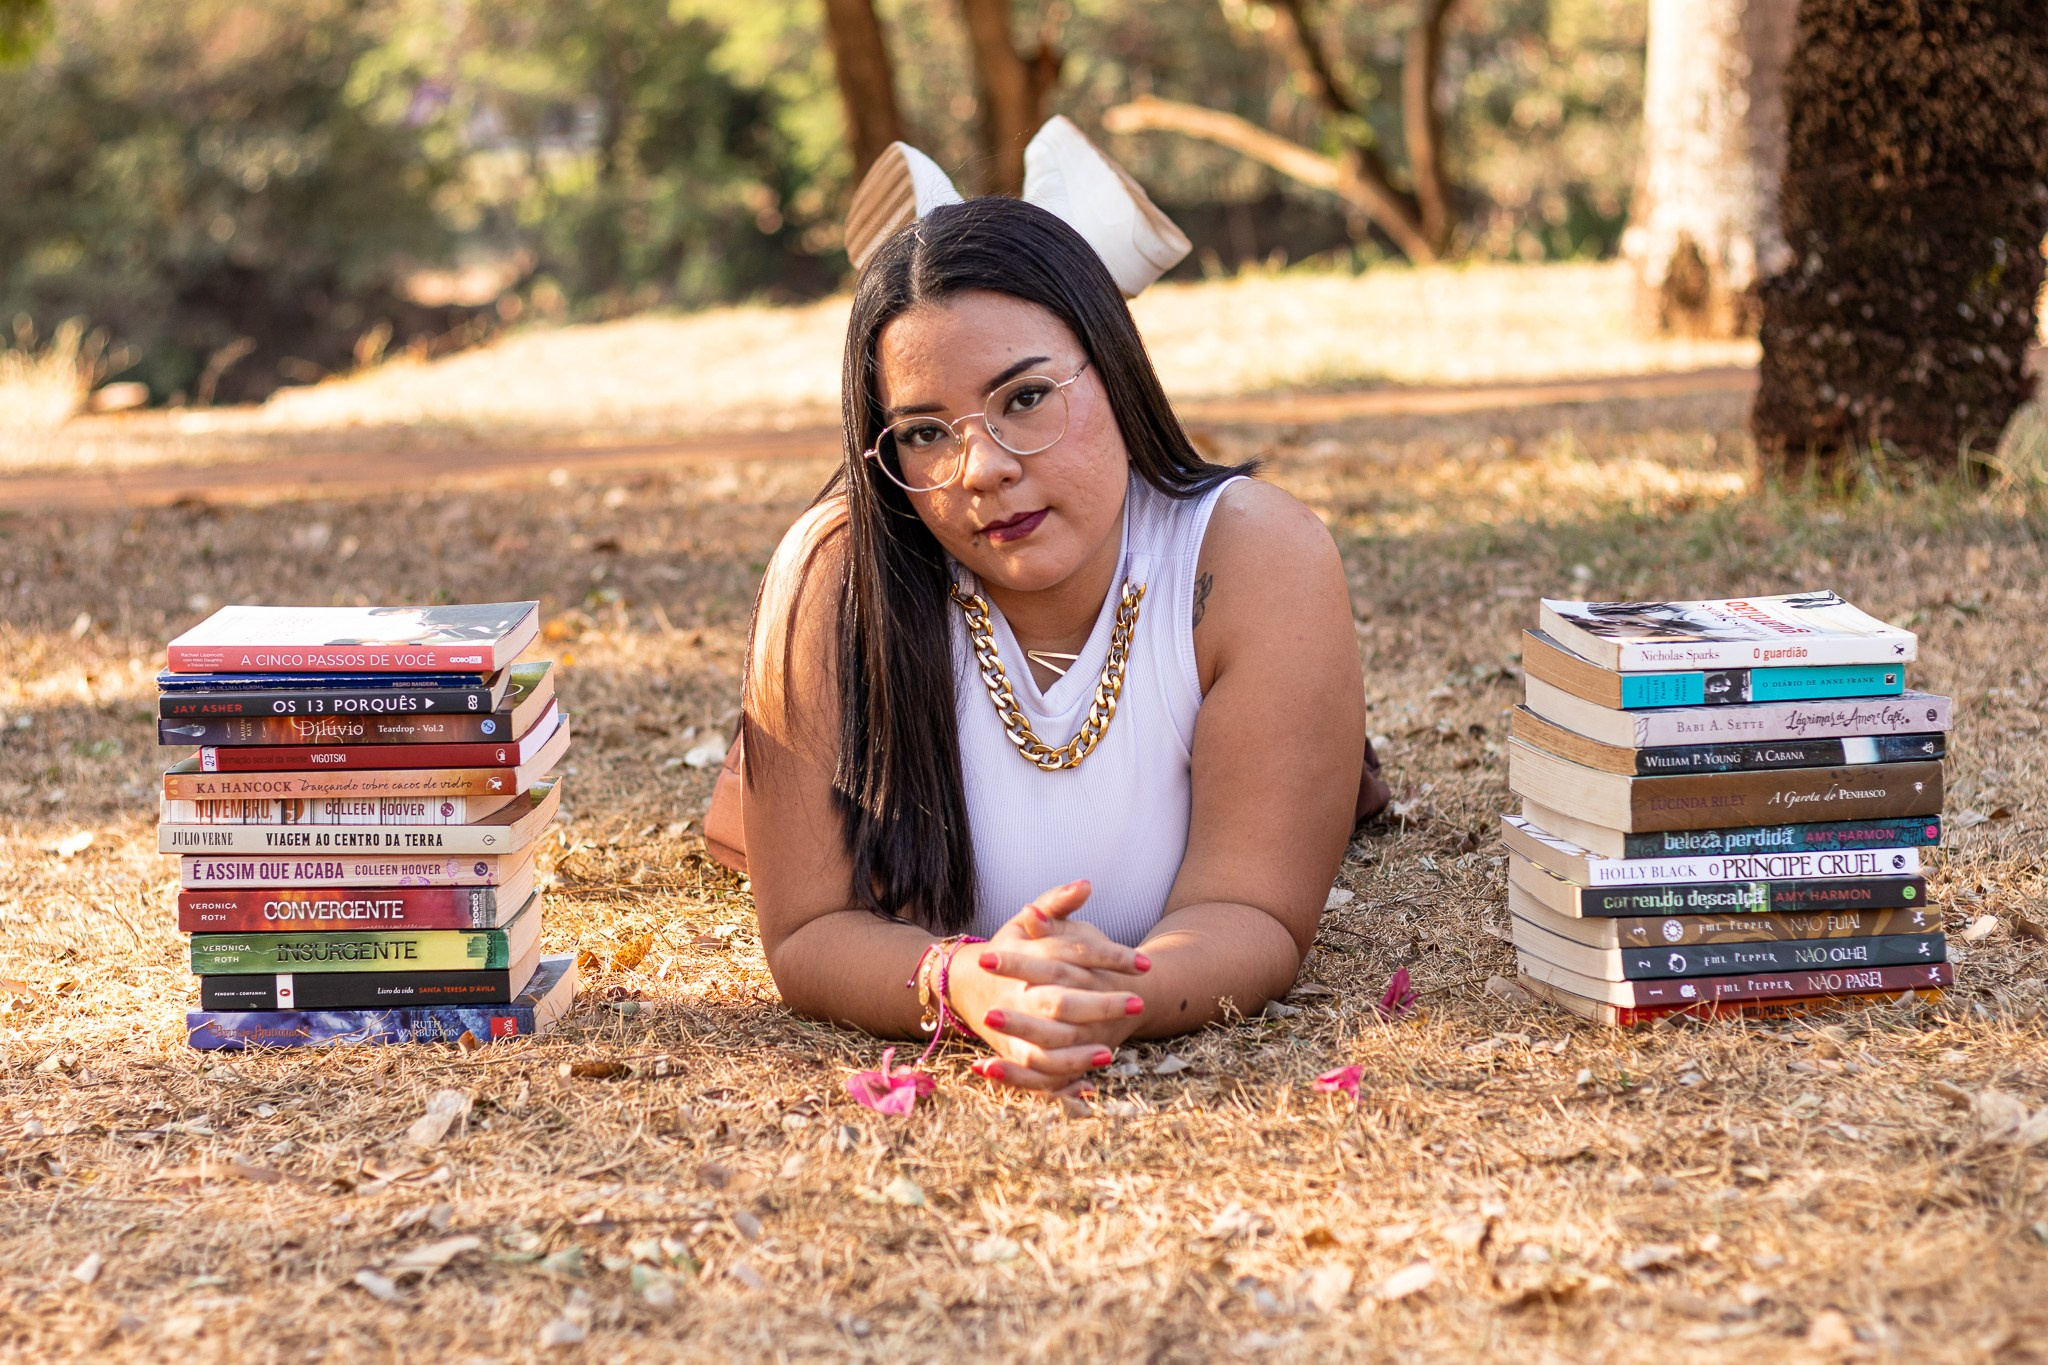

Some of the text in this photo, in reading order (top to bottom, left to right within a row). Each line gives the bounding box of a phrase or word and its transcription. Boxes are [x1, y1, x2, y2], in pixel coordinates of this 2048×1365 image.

[240, 651, 436, 666] A CINCO PASSOS DE VOCÊ
[1641, 648, 1720, 663] Nicholas Sparks
[1753, 646, 1808, 661] O guardião
[1772, 678, 1803, 688] DIÁRIO
[1846, 677, 1875, 685] FRANK
[173, 703, 243, 714] JAY ASHER
[273, 695, 417, 713] OS 13 PORQUÊS
[299, 719, 364, 737] Dilúvio
[377, 724, 415, 734] Teardrop
[422, 723, 444, 733] Vol.2
[1676, 718, 1765, 733] BABI A. SETTE
[1785, 709, 1835, 736] Lágrimas
[1844, 706, 1878, 731] Amor
[310, 753, 347, 764] VIGOTSKI
[1645, 752, 1742, 768] WILLIAM P. YOUNG
[1755, 749, 1805, 762] A CABANA
[196, 781, 292, 794] KA HANCOCK
[298, 776, 473, 795] Dançando sobre cacos de vidro
[1651, 794, 1746, 811] LUCINDA RILEY
[1768, 783, 1886, 809] A Garota do PENHASCO
[195, 799, 273, 821] NOVEMBRO,
[325, 802, 425, 816] COLLEEN HOOVER
[172, 829, 234, 846] JÚLIO VERNE
[265, 832, 444, 847] VIAGEM AO CENTRO DA TERRA
[1664, 826, 1795, 852] beleza perdida
[1805, 828, 1896, 843] AMY HARMON
[193, 860, 345, 880] É ASSIM QUE ACABA
[355, 864, 441, 876] COLLEEN HOOVER
[1600, 864, 1698, 880] HOLLY BLACK
[1708, 853, 1883, 879] O PRÍNCIPE CRUEL
[1603, 886, 1766, 910] correndo descalça
[1775, 889, 1872, 902] AMY HARMON
[263, 900, 404, 920] CONVERGENTE
[1633, 927, 1648, 936] 3
[202, 944, 251, 952] VERONICA
[276, 941, 418, 963] INSURGENTE
[1795, 945, 1868, 964] NÃO OLHE!
[1638, 960, 1651, 969] 2
[469, 984, 496, 992] D'ÁVILA
[1808, 971, 1883, 991] NÃO PARE!
[377, 987, 393, 995] Livro
[401, 986, 414, 994] vida
[413, 1020, 441, 1029] RUTH
[396, 1028, 459, 1037] WARBURTON
